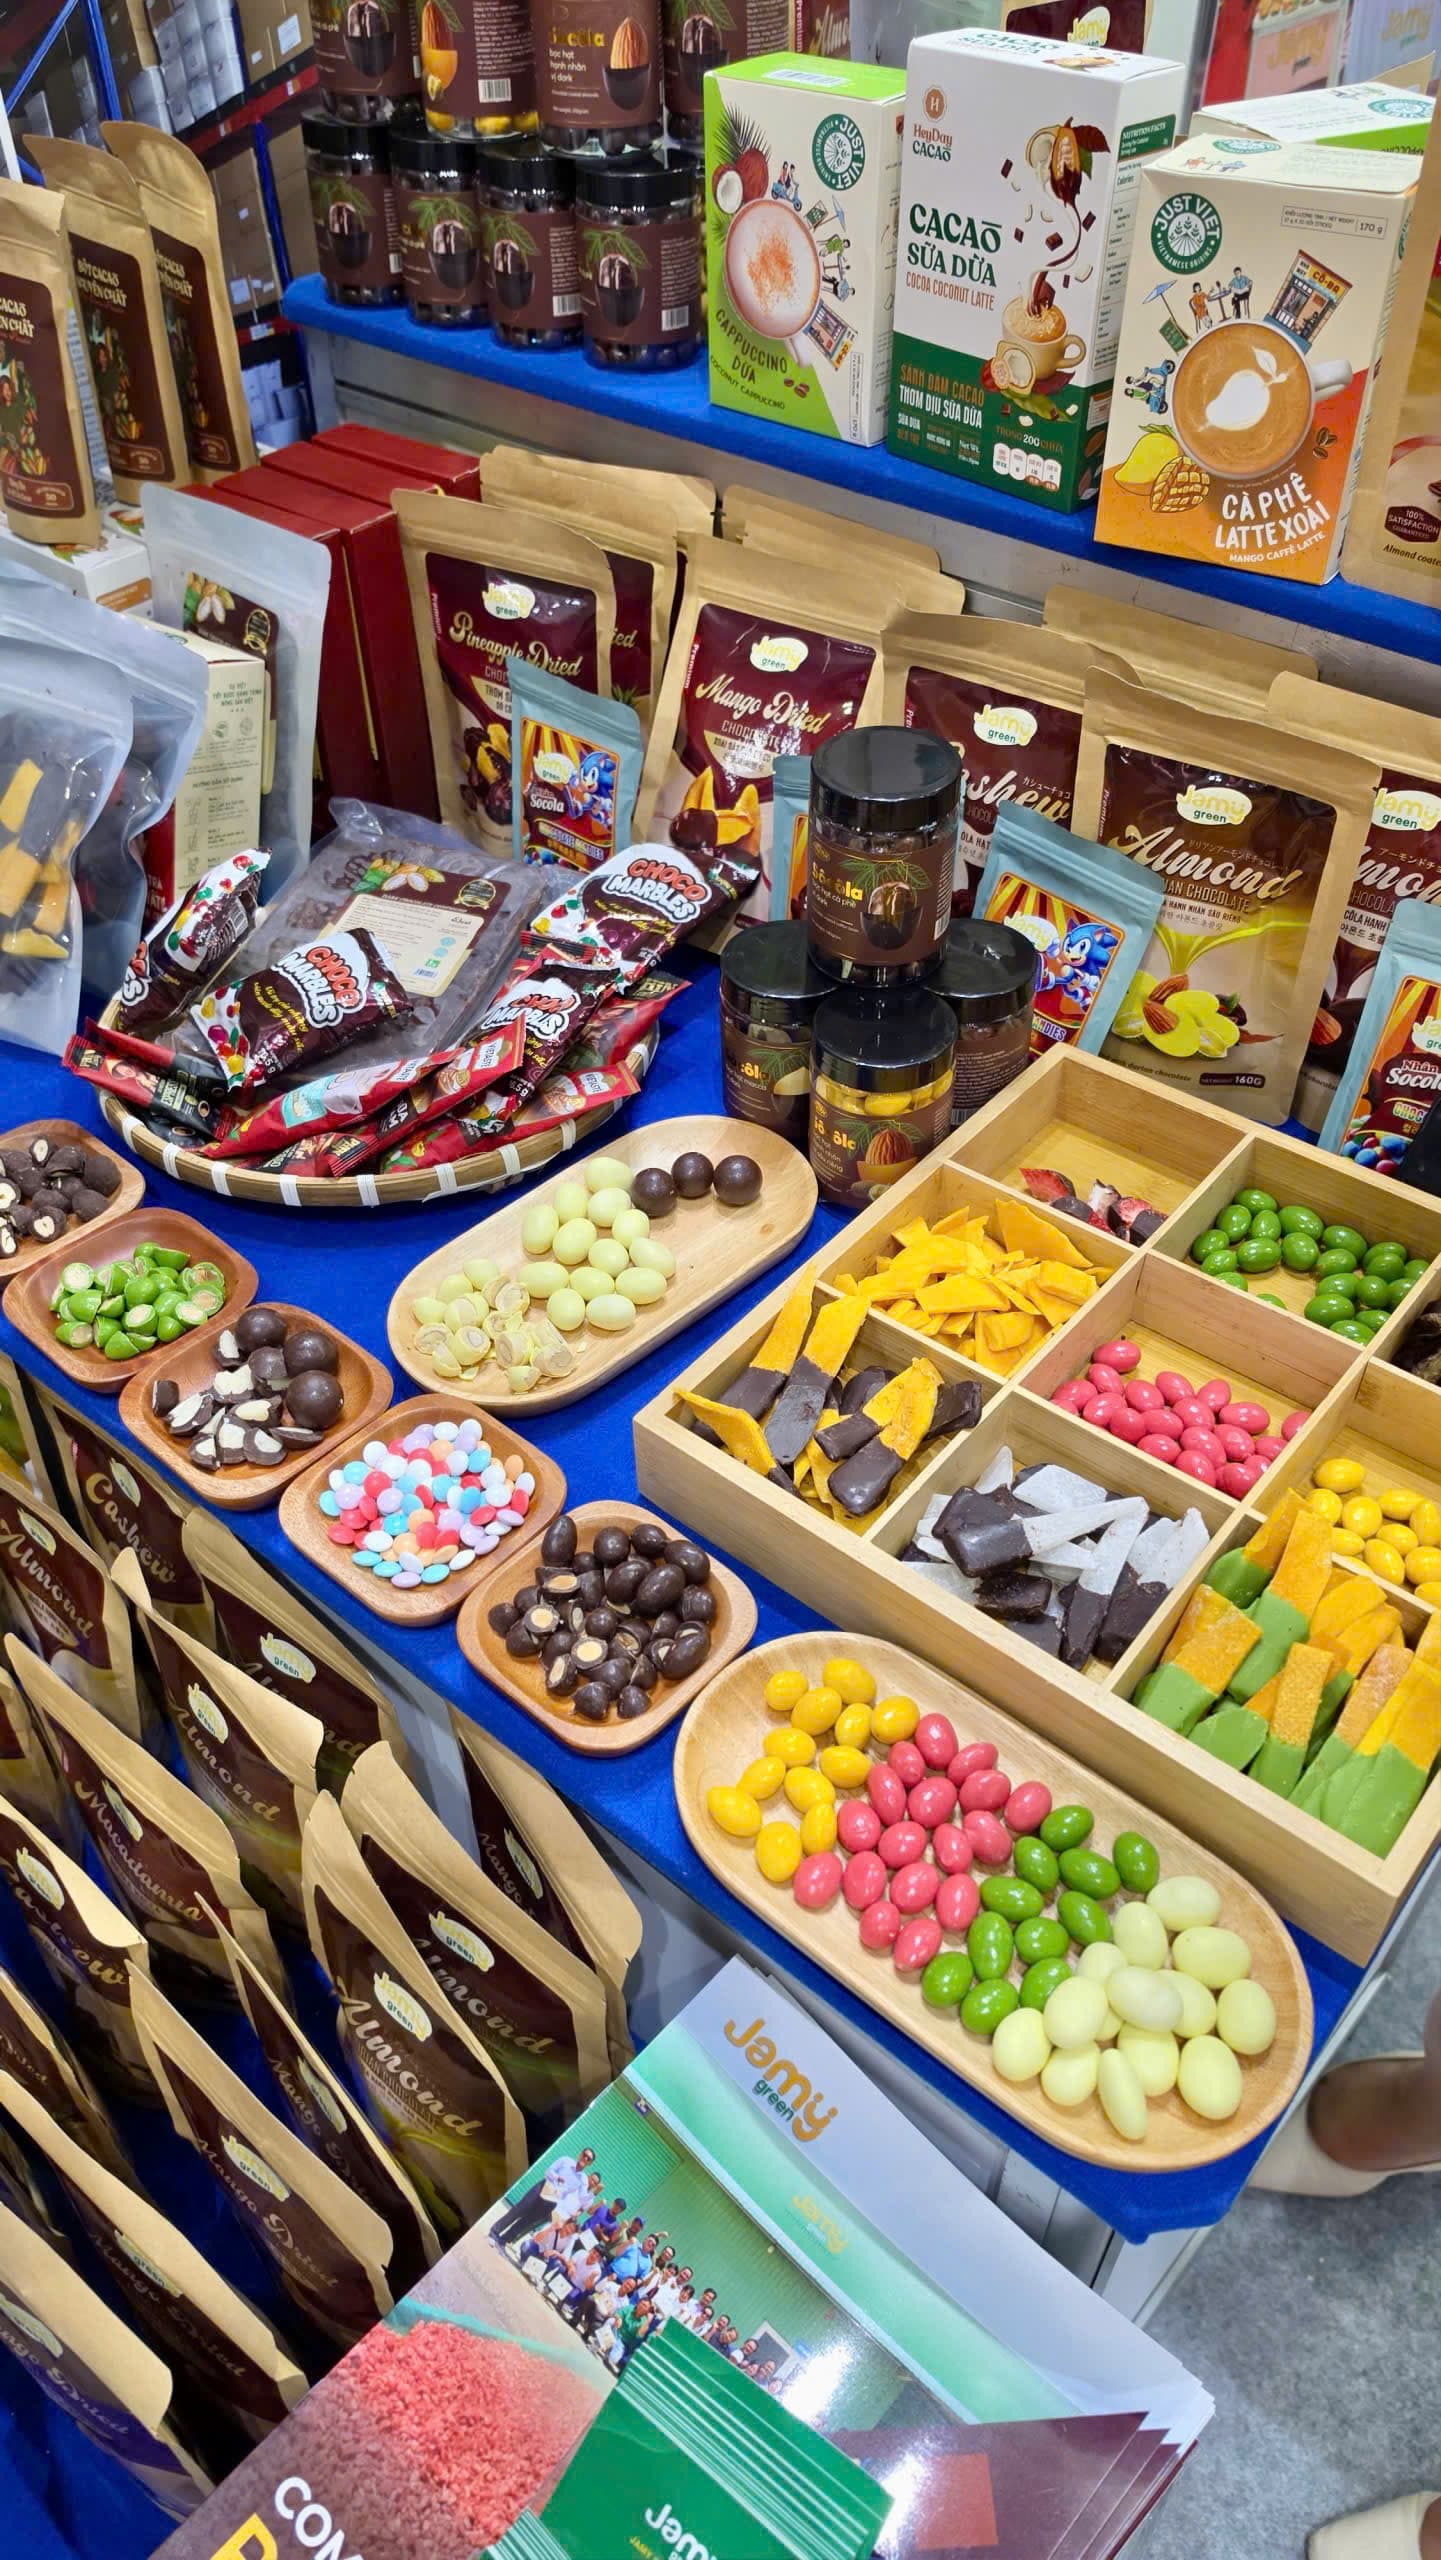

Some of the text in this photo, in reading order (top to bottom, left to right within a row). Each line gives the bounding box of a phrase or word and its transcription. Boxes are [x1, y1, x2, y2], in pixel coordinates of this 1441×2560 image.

[836, 116, 865, 190] JUST VIET
[912, 124, 952, 147] HeyDay
[1154, 195, 1221, 240] JUST VIET
[1360, 222, 1376, 232] 170
[907, 241, 947, 274] SỮA
[906, 271, 995, 311] COCOA COCONUT LATTE
[715, 308, 789, 375] CAPPUCCINO
[1221, 472, 1313, 522] CÀ PHÊ
[1404, 509, 1425, 522] 100%
[1214, 500, 1332, 551] LATTE XOÀI
[1388, 513, 1440, 535] SATISFACTION
[1228, 553, 1265, 564] MANGO
[1296, 531, 1327, 553] LATTE
[1382, 543, 1417, 562] Almond
[495, 605, 519, 618] green
[449, 611, 584, 677] Pineapple Dried
[611, 627, 638, 649] ied
[761, 655, 787, 670] green
[695, 673, 832, 735] Mango Dried
[975, 705, 1034, 745] Jamy
[987, 728, 1017, 744] green
[541, 769, 562, 782] green
[529, 792, 566, 814] Socola
[1177, 786, 1246, 824] Jamy
[1193, 808, 1227, 824] green
[1374, 787, 1441, 832] Jamy
[1381, 813, 1419, 829] green
[627, 858, 707, 902] CHOCO
[1108, 825, 1304, 901] Almond
[606, 874, 698, 920] MARBLES
[1186, 884, 1251, 915] CHOCOLATE
[1005, 912, 1052, 950] Jamy
[275, 951, 339, 1027] MARBLES
[305, 945, 362, 1008] CHOCO
[1032, 1015, 1067, 1042] ANDIES
[1154, 1068, 1192, 1083] chocolate
[1234, 1075, 1264, 1088] 160G
[1385, 1067, 1441, 1090] Socol
[1400, 1059, 1440, 1074] Nhân
[84, 1472, 177, 1584] Cashew
[0, 1517, 94, 1639] Almond
[273, 1655, 300, 1678] green
[167, 1688, 281, 1822] Almond
[75, 1780, 205, 1922] Macadamia
[445, 1935, 475, 1963] green
[385, 1999, 414, 2032] green
[336, 1975, 483, 2137] Almond
[267, 2056, 322, 2137] Mango
[723, 2017, 839, 2143] Jamy
[751, 2078, 796, 2123] green
[239, 2159, 273, 2193] green
[198, 2138, 339, 2288] Mango Dried
[133, 2254, 166, 2288] green
[644, 2503, 718, 2560] Jam
